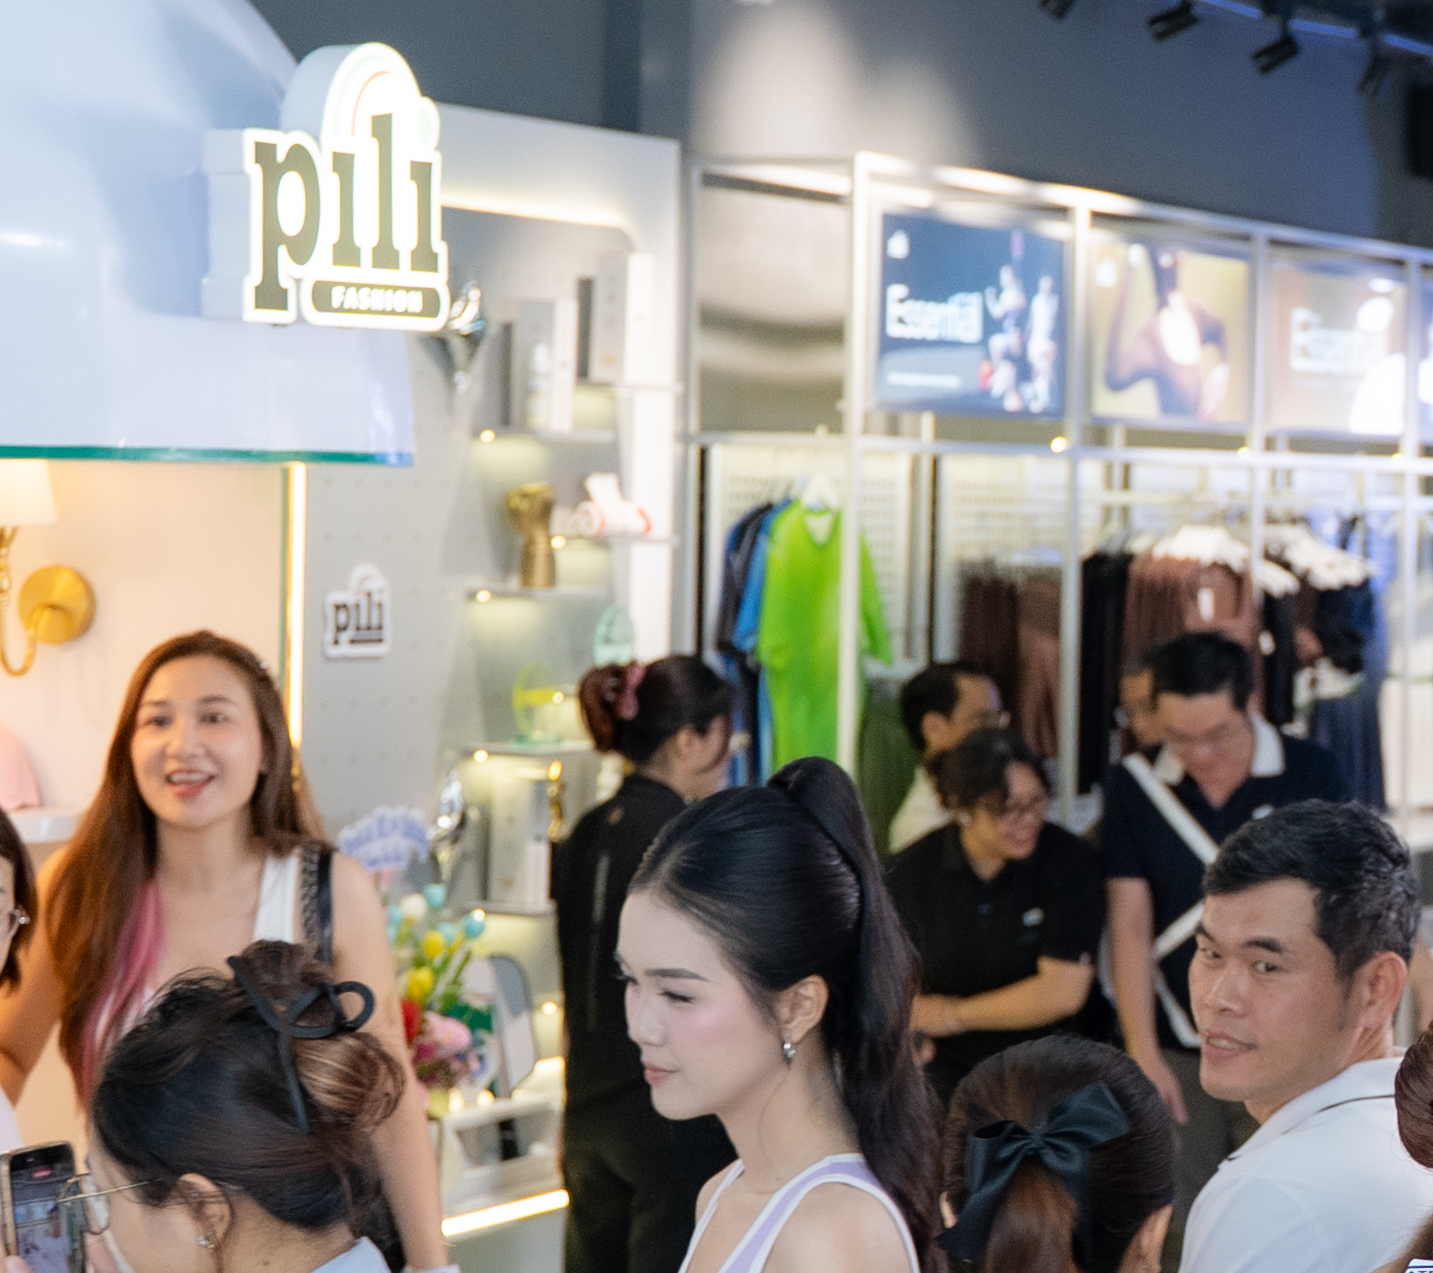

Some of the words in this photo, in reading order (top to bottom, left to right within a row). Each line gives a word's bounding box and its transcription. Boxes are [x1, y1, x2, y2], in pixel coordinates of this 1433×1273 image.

[254, 112, 439, 311] pili
[330, 285, 424, 314] FASHION
[331, 590, 384, 645] pili
